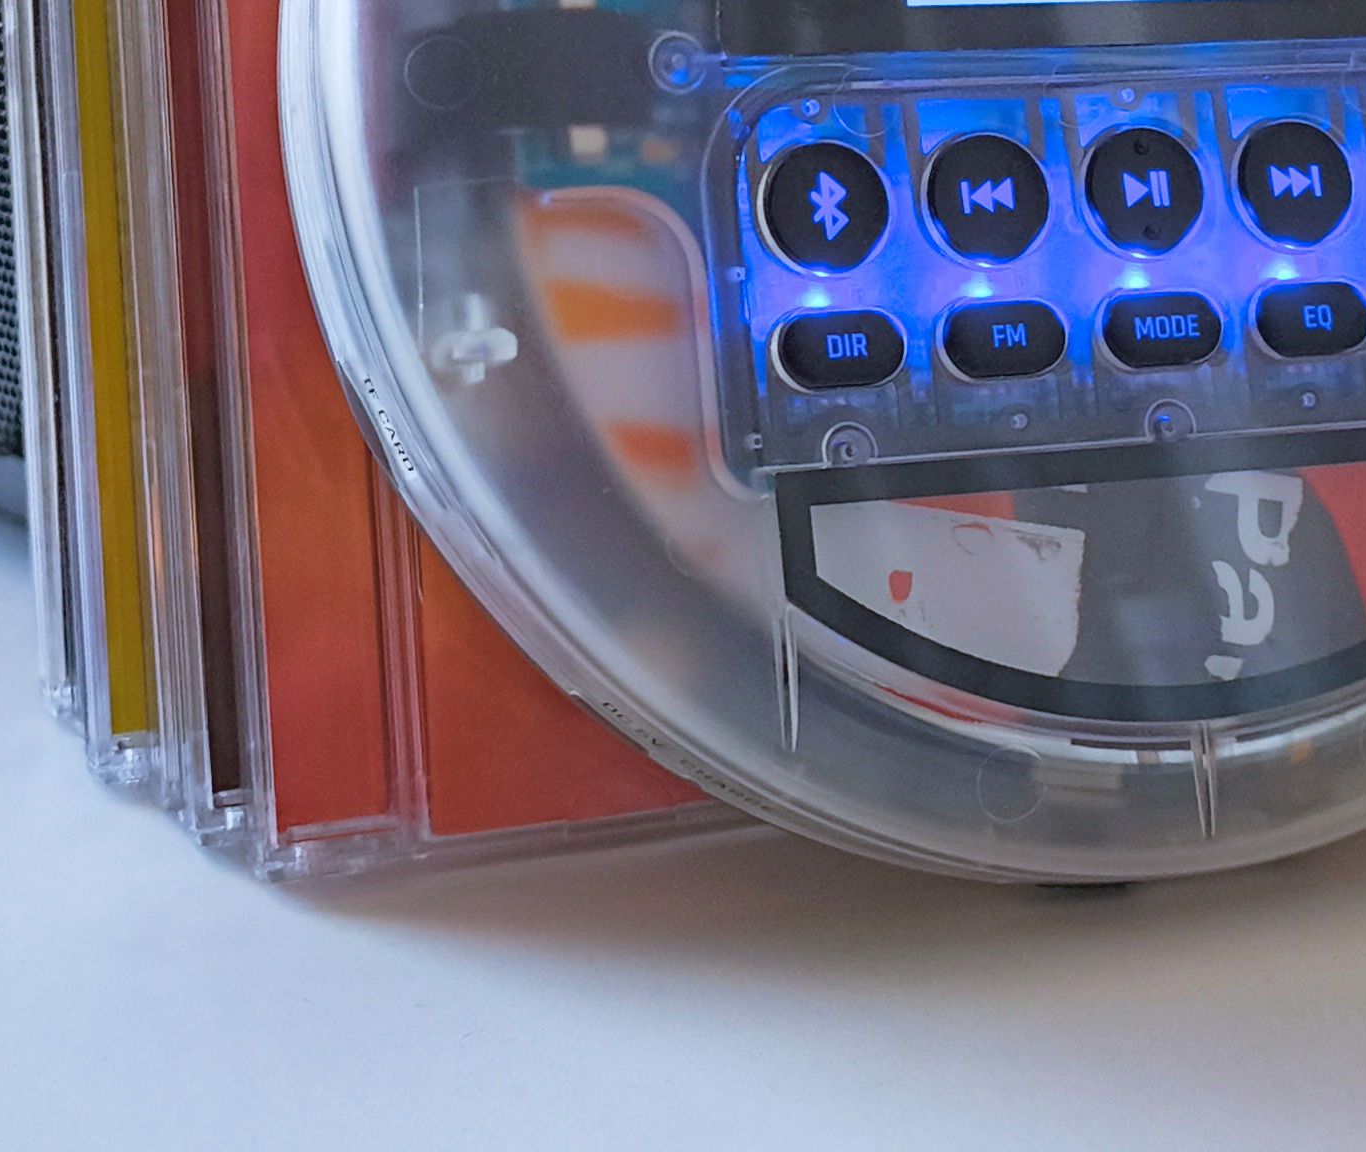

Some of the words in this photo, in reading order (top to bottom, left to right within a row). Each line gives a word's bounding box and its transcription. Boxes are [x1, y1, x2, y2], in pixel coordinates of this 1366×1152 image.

[1135, 314, 1201, 340] MODE
[1303, 304, 1333, 332] EQ
[826, 333, 868, 359] DIR
[992, 323, 1027, 348] FM
[364, 375, 379, 400] TF
[379, 410, 414, 471] CARD
